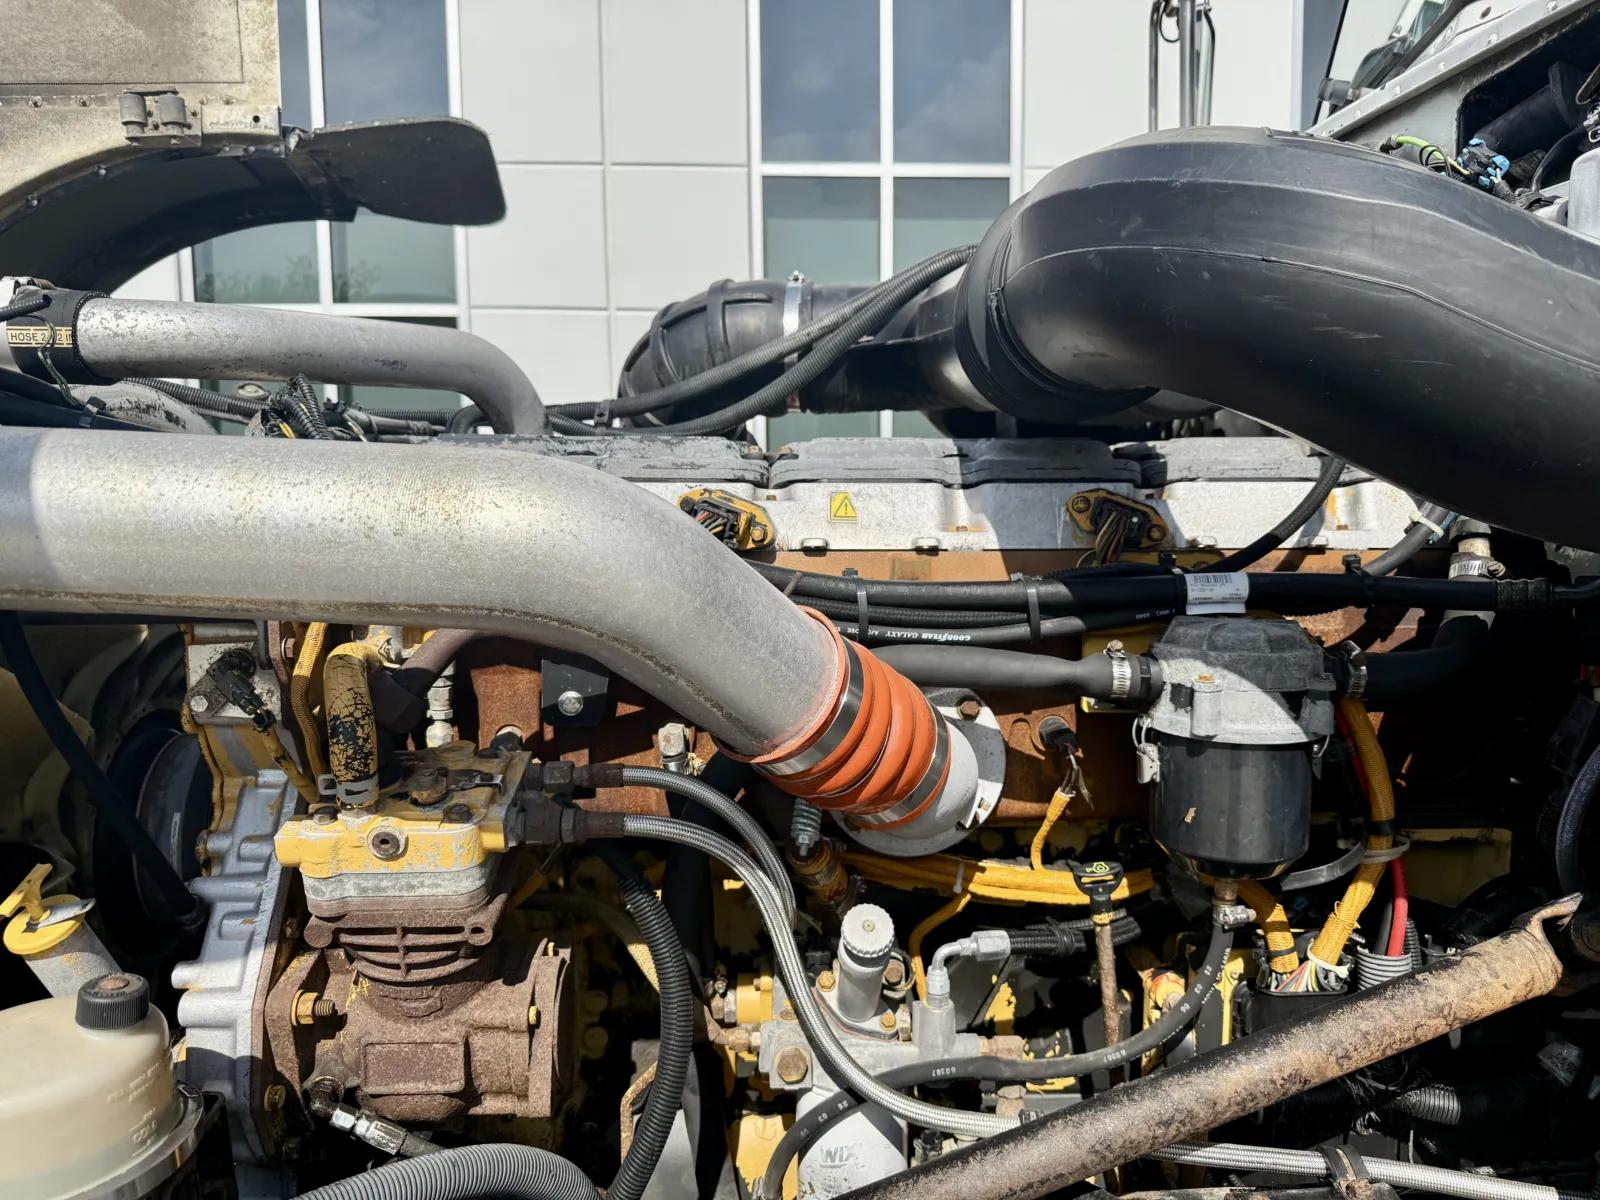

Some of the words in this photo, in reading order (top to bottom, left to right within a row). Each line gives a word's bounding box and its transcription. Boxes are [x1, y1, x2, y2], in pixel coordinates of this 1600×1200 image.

[10, 332, 38, 341] HOSE
[885, 630, 919, 639] GALAXY
[921, 632, 971, 641] GOODYEAR
